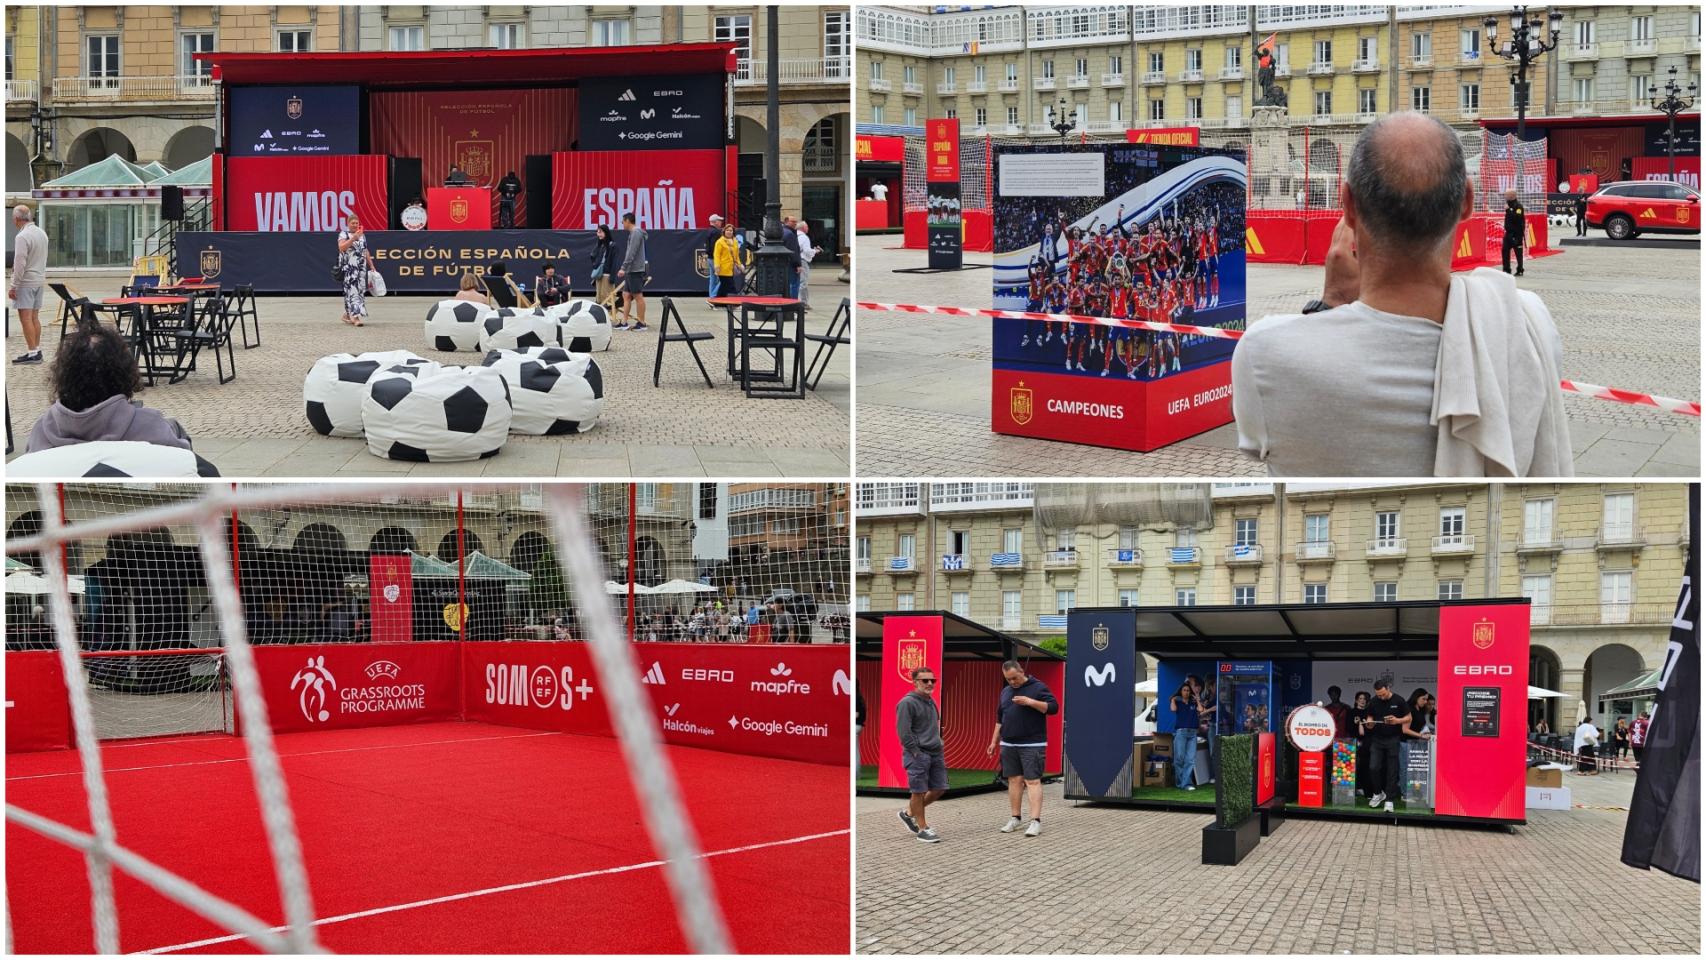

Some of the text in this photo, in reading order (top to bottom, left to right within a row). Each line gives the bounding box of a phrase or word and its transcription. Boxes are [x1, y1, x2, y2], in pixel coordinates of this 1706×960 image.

[600, 115, 627, 123] mapfre
[627, 131, 683, 141] Google Gemini
[1171, 132, 1193, 145] OFICIAL
[255, 190, 355, 231] VAMOS
[584, 179, 697, 230] ESPAÑA
[460, 246, 571, 260] ESPAÑOLA
[399, 265, 424, 276] DE
[1168, 384, 1233, 415] UEFA EURO2024
[1047, 399, 1124, 419] CAMPEONES
[366, 663, 398, 678] UEFA
[682, 668, 734, 682] EBRO
[1454, 665, 1512, 675] EBRO
[340, 684, 425, 700] GRASSROOTS
[751, 679, 811, 696] mapfre
[340, 698, 426, 713] PROGRAMME
[663, 717, 715, 735] Halcón viajes
[741, 717, 828, 737] Google Gemini
[1295, 728, 1331, 736] TODOS
